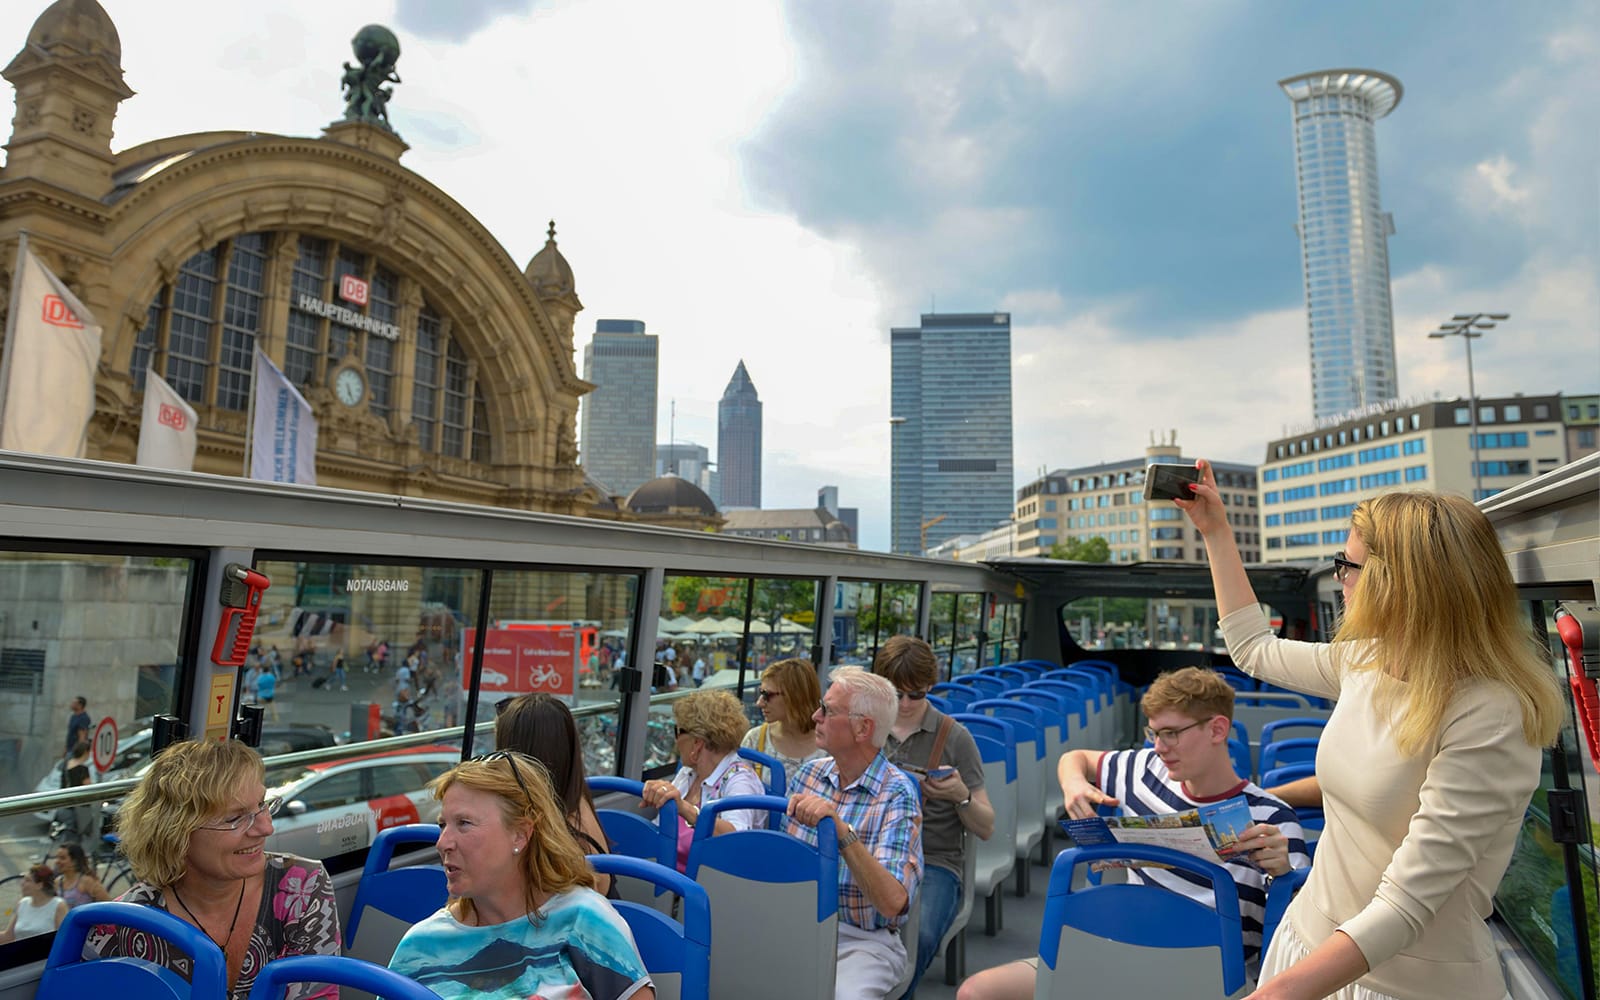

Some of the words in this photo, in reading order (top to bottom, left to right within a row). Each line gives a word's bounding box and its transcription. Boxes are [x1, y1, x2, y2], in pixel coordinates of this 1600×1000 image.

[345, 277, 367, 303] DB
[299, 293, 401, 341] HAUPTBAHNHOF
[160, 406, 185, 428] DB
[346, 579, 409, 592] NOTAUSGANG
[100, 731, 112, 756] 10
